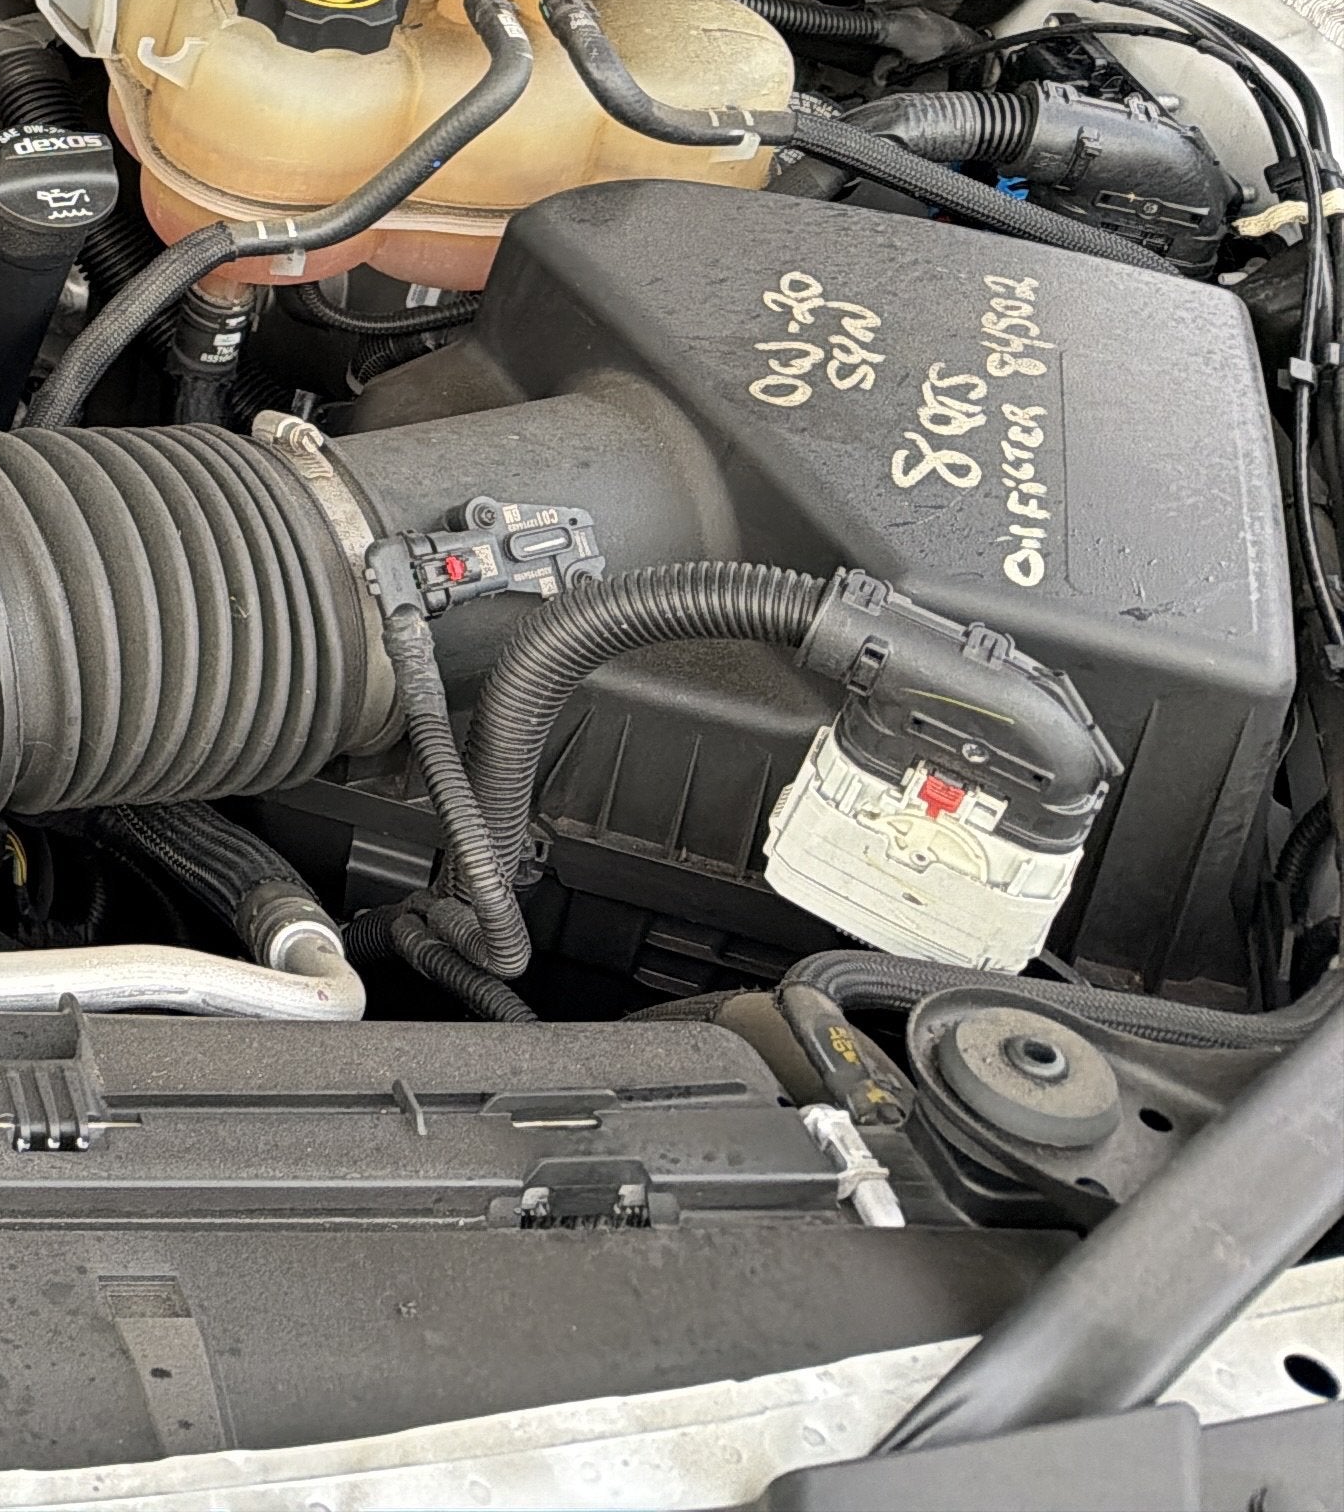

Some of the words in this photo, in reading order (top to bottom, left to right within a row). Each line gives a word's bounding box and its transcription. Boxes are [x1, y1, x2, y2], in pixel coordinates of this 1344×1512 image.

[13, 135, 103, 155] dexos
[824, 300, 886, 390] SYN
[916, 361, 988, 436] QTS
[891, 431, 983, 488] 8
